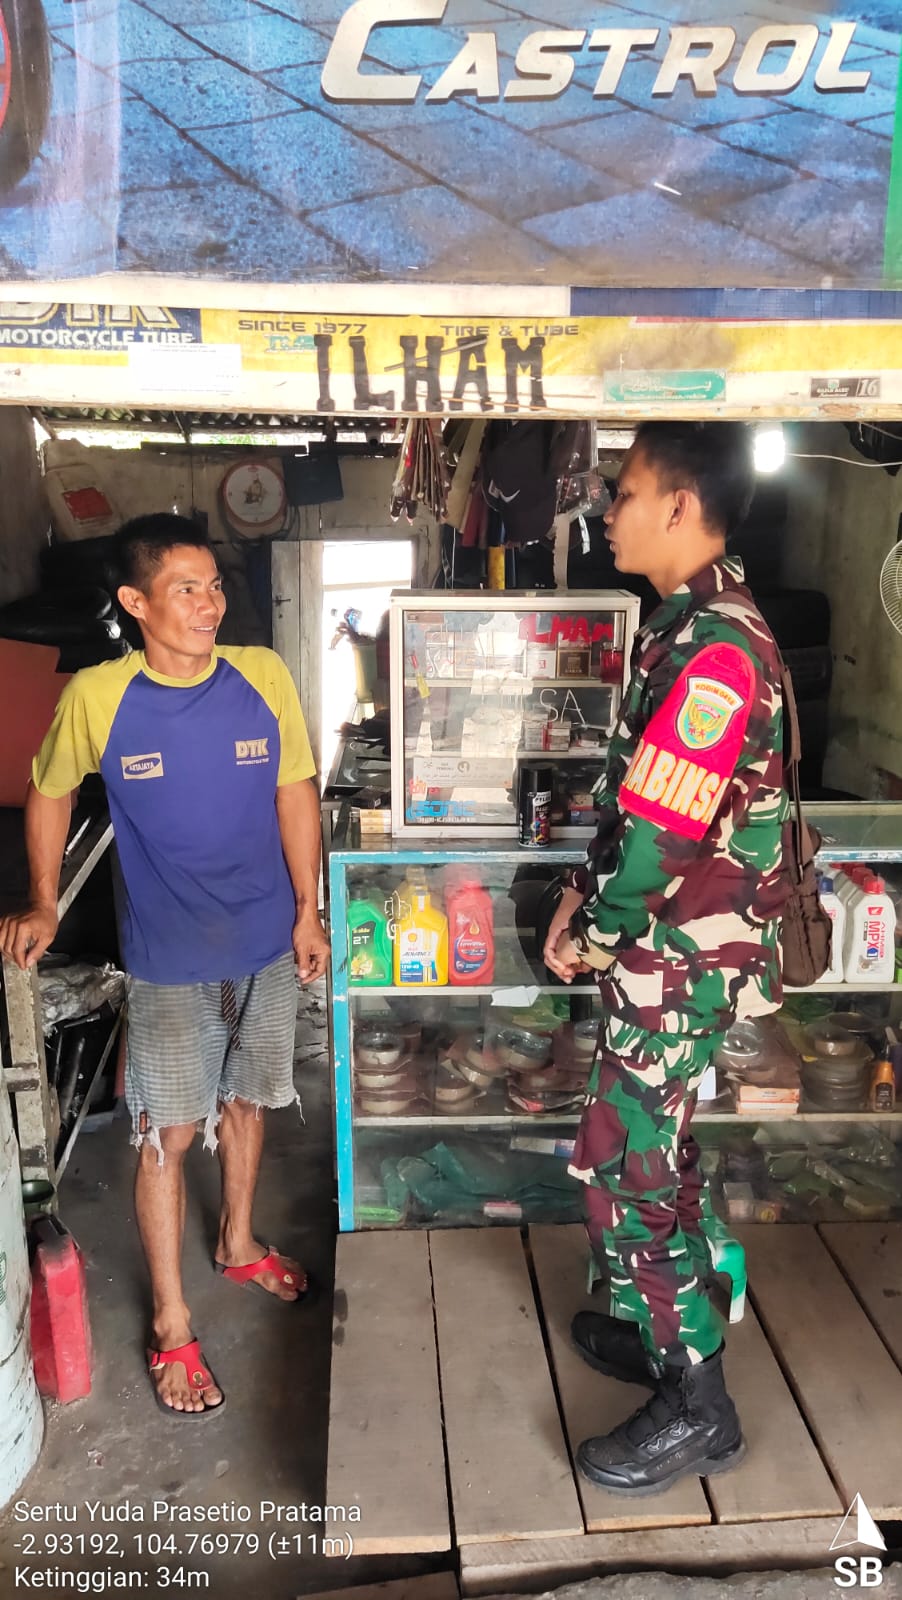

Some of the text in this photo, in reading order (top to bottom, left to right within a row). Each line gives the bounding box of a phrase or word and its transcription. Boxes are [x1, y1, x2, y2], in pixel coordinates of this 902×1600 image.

[238, 319, 367, 334] SINCE 1977
[440, 324, 579, 337] TIRE & TUBE
[0, 328, 134, 346] MOTORCYCLE
[313, 333, 548, 413] ILHAM
[859, 379, 880, 396] 16
[235, 738, 269, 758] DTK
[353, 935, 370, 945] 2T
